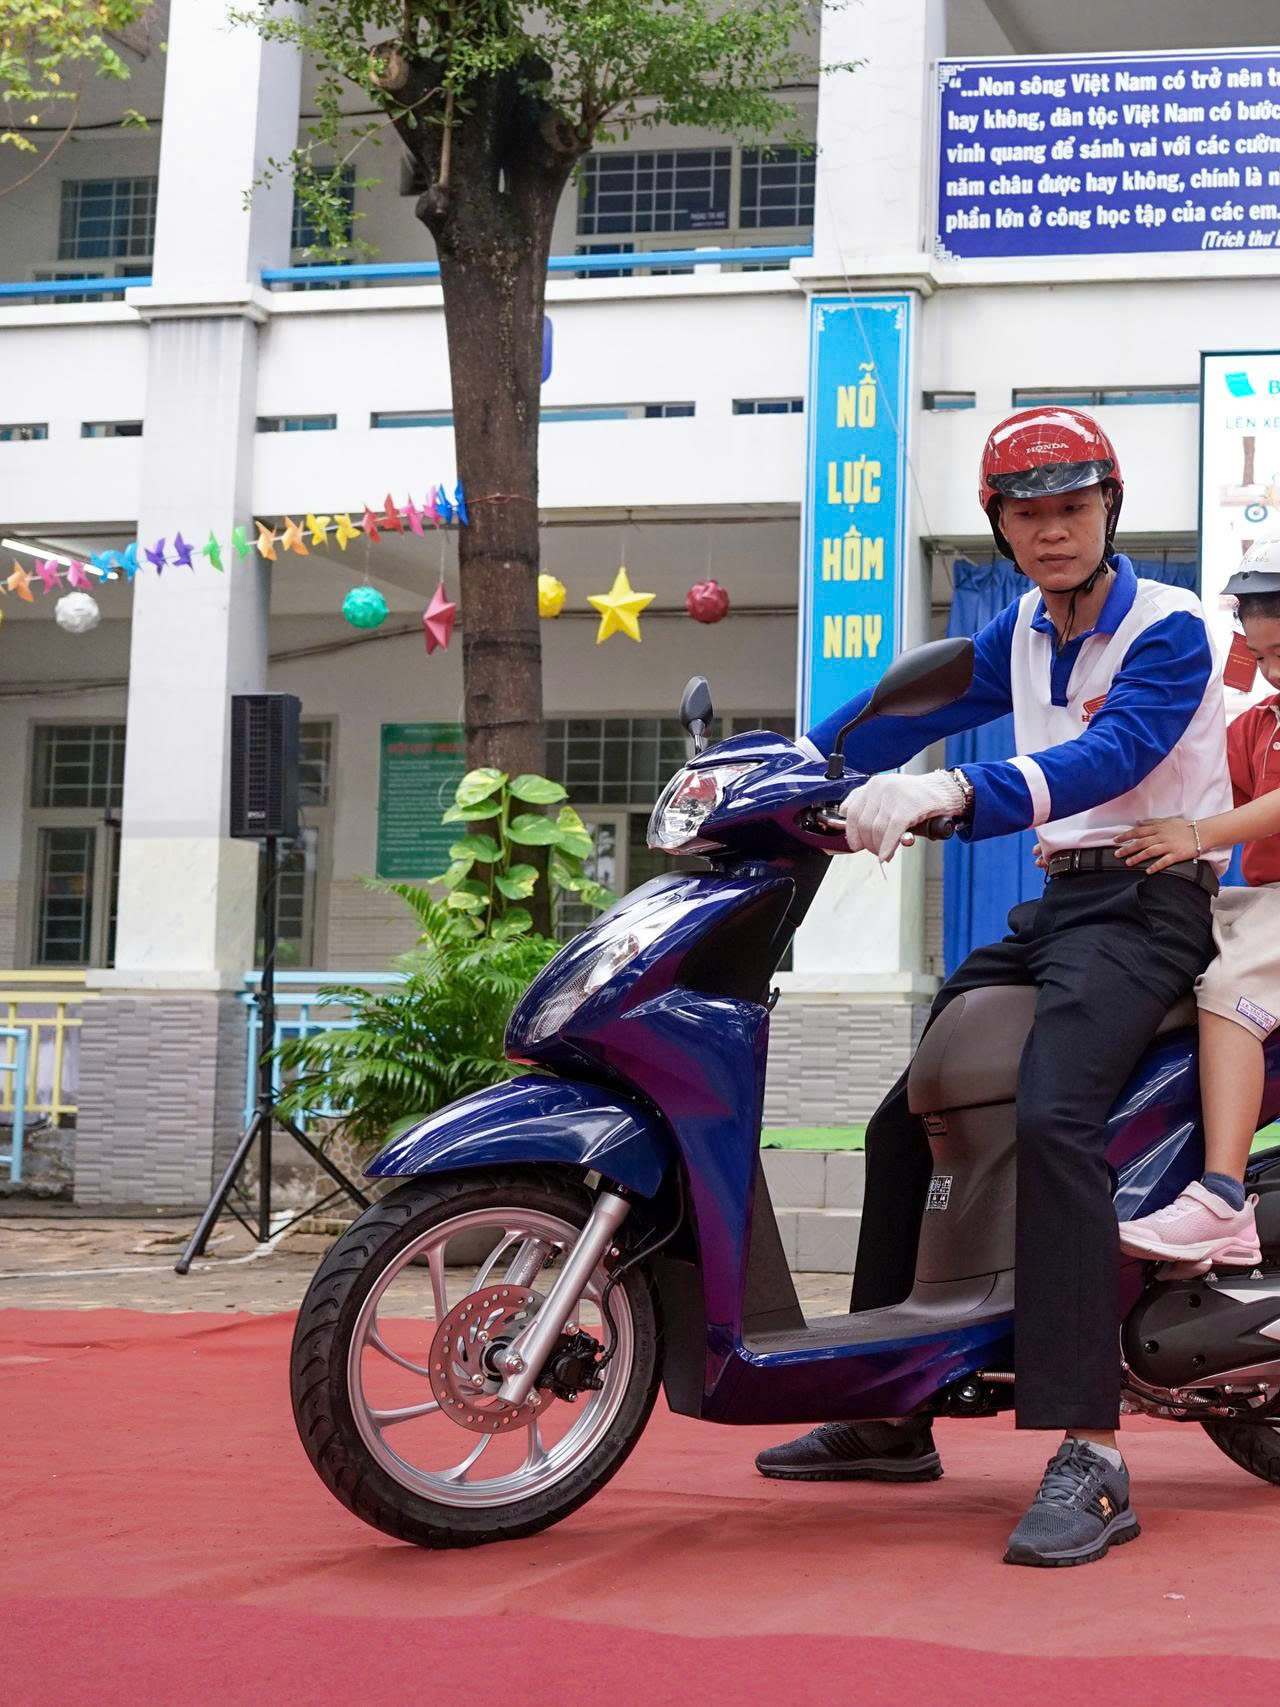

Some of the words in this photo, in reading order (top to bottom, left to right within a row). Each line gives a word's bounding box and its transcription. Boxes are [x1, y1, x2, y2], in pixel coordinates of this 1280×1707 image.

[1020, 76, 1066, 97] sông
[1071, 73, 1109, 97] Việt
[1116, 72, 1157, 91] Nam
[1162, 70, 1185, 90] có
[1191, 67, 1222, 89] trở
[1227, 68, 1262, 87] nên
[949, 111, 978, 132] hay
[984, 109, 1045, 131] không,
[1051, 107, 1083, 126] dân
[1088, 106, 1118, 129] tộc
[1123, 105, 1159, 128] Việt
[1165, 103, 1204, 122] Nam
[1209, 101, 1231, 121] có
[948, 143, 985, 162] vinh
[991, 146, 1046, 165] quang
[1051, 136, 1075, 159] để
[1080, 138, 1124, 159] sánh
[1130, 137, 1157, 157] vai
[1162, 136, 1190, 156] với
[1196, 135, 1229, 155] các
[947, 178, 984, 196] năm
[990, 175, 1032, 195] châu
[1038, 174, 1080, 196] được
[1086, 173, 1117, 194] hay
[1123, 171, 1185, 192] không,
[1191, 168, 1239, 188] chính
[1246, 167, 1262, 186] là
[947, 207, 990, 232] phần
[996, 208, 1023, 228] lớn
[1029, 205, 1042, 227] ở
[1047, 207, 1091, 229] công
[1097, 205, 1130, 228] học
[1135, 204, 1166, 227] tập
[1172, 200, 1205, 222] của
[1211, 201, 1244, 221] các
[1202, 231, 1245, 249] (Trích
[837, 362, 876, 428] NỖ
[1026, 442, 1069, 453] HONDA
[827, 454, 882, 512] LỰC
[822, 524, 883, 581] HÔM
[824, 615, 882, 658] NAY
